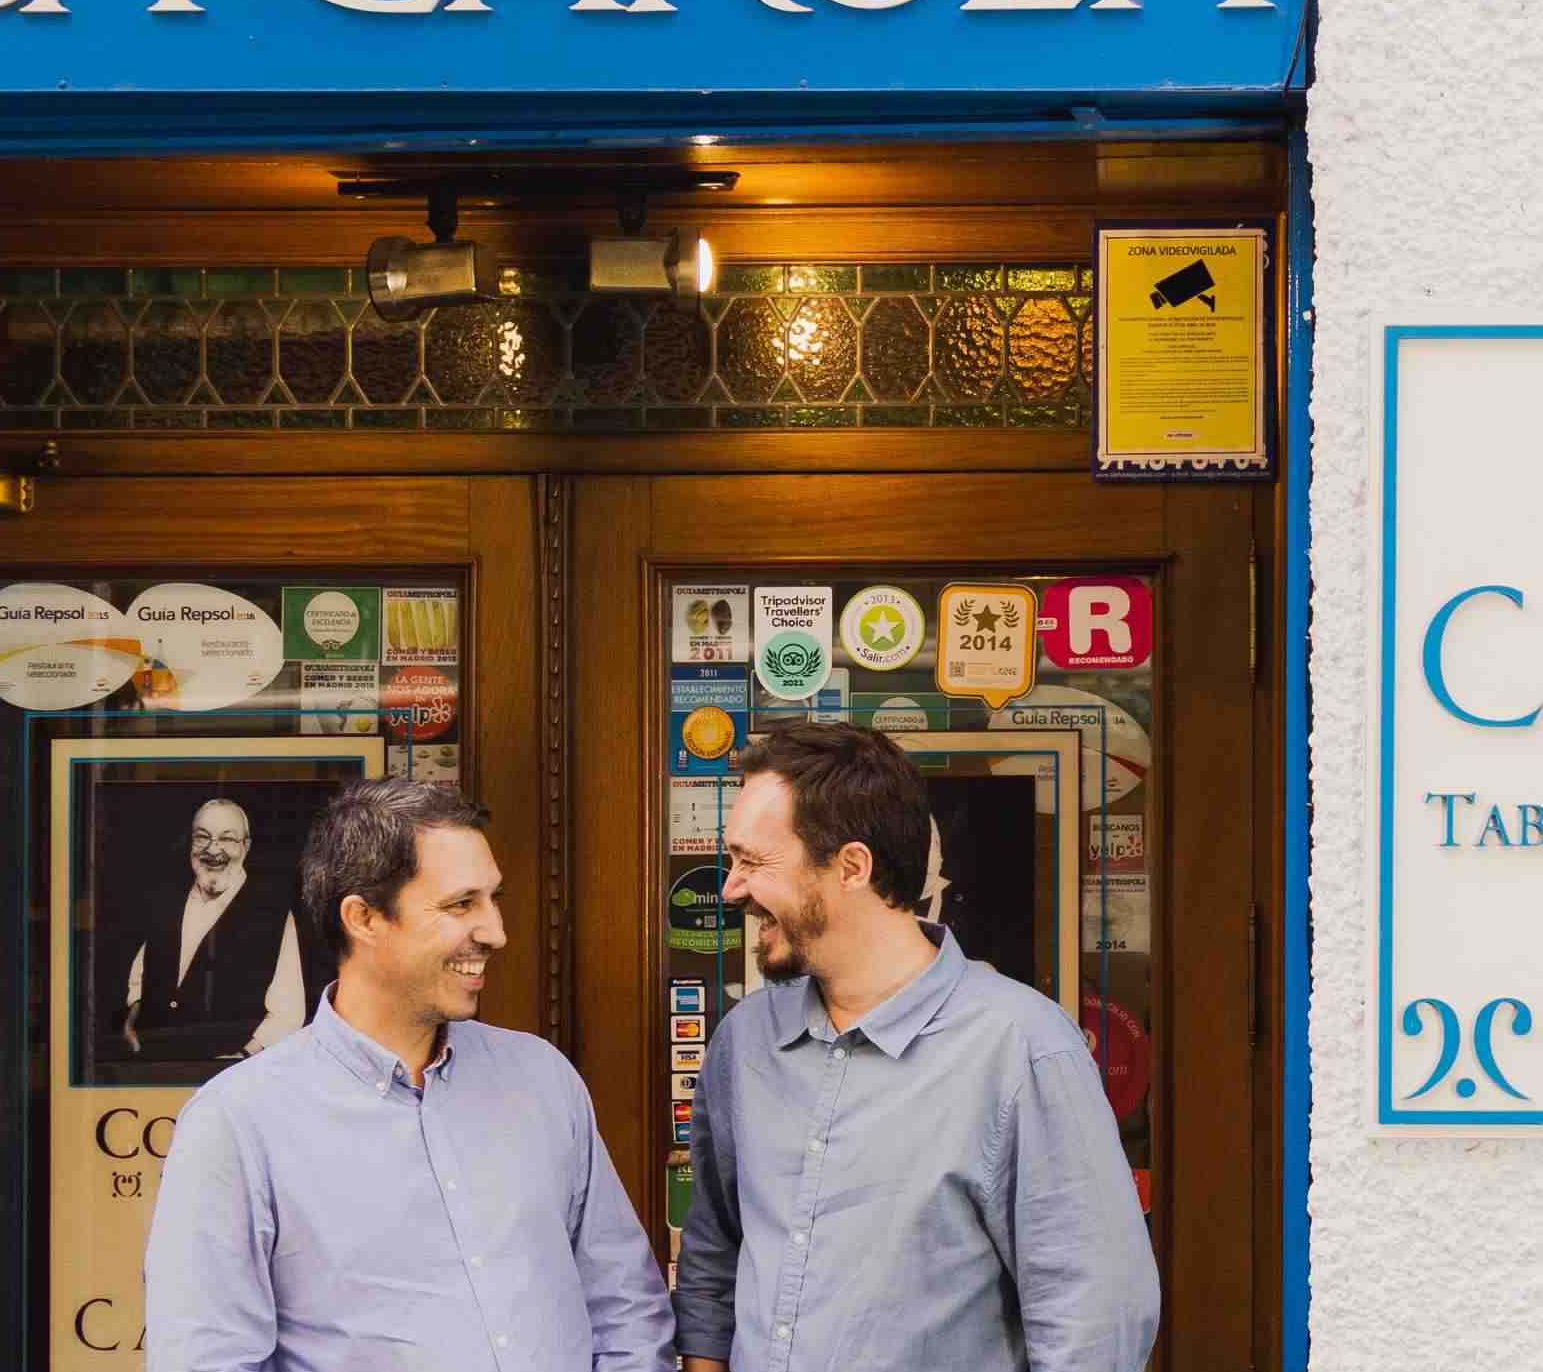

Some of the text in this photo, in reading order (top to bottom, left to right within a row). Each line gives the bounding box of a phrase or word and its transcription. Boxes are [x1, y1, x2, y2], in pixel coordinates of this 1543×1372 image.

[1128, 246, 1236, 255] ZONA VIDEOVIGILADA
[760, 595, 826, 607] Tripadvisor
[35, 607, 85, 623] Repsol
[181, 606, 234, 624] Repsol
[764, 606, 823, 616] Travellers'
[772, 617, 813, 627] Choice
[1069, 586, 1132, 655] R
[959, 635, 1012, 651] 2014
[674, 695, 744, 703] RECOMENDADO
[391, 703, 432, 727] yelp
